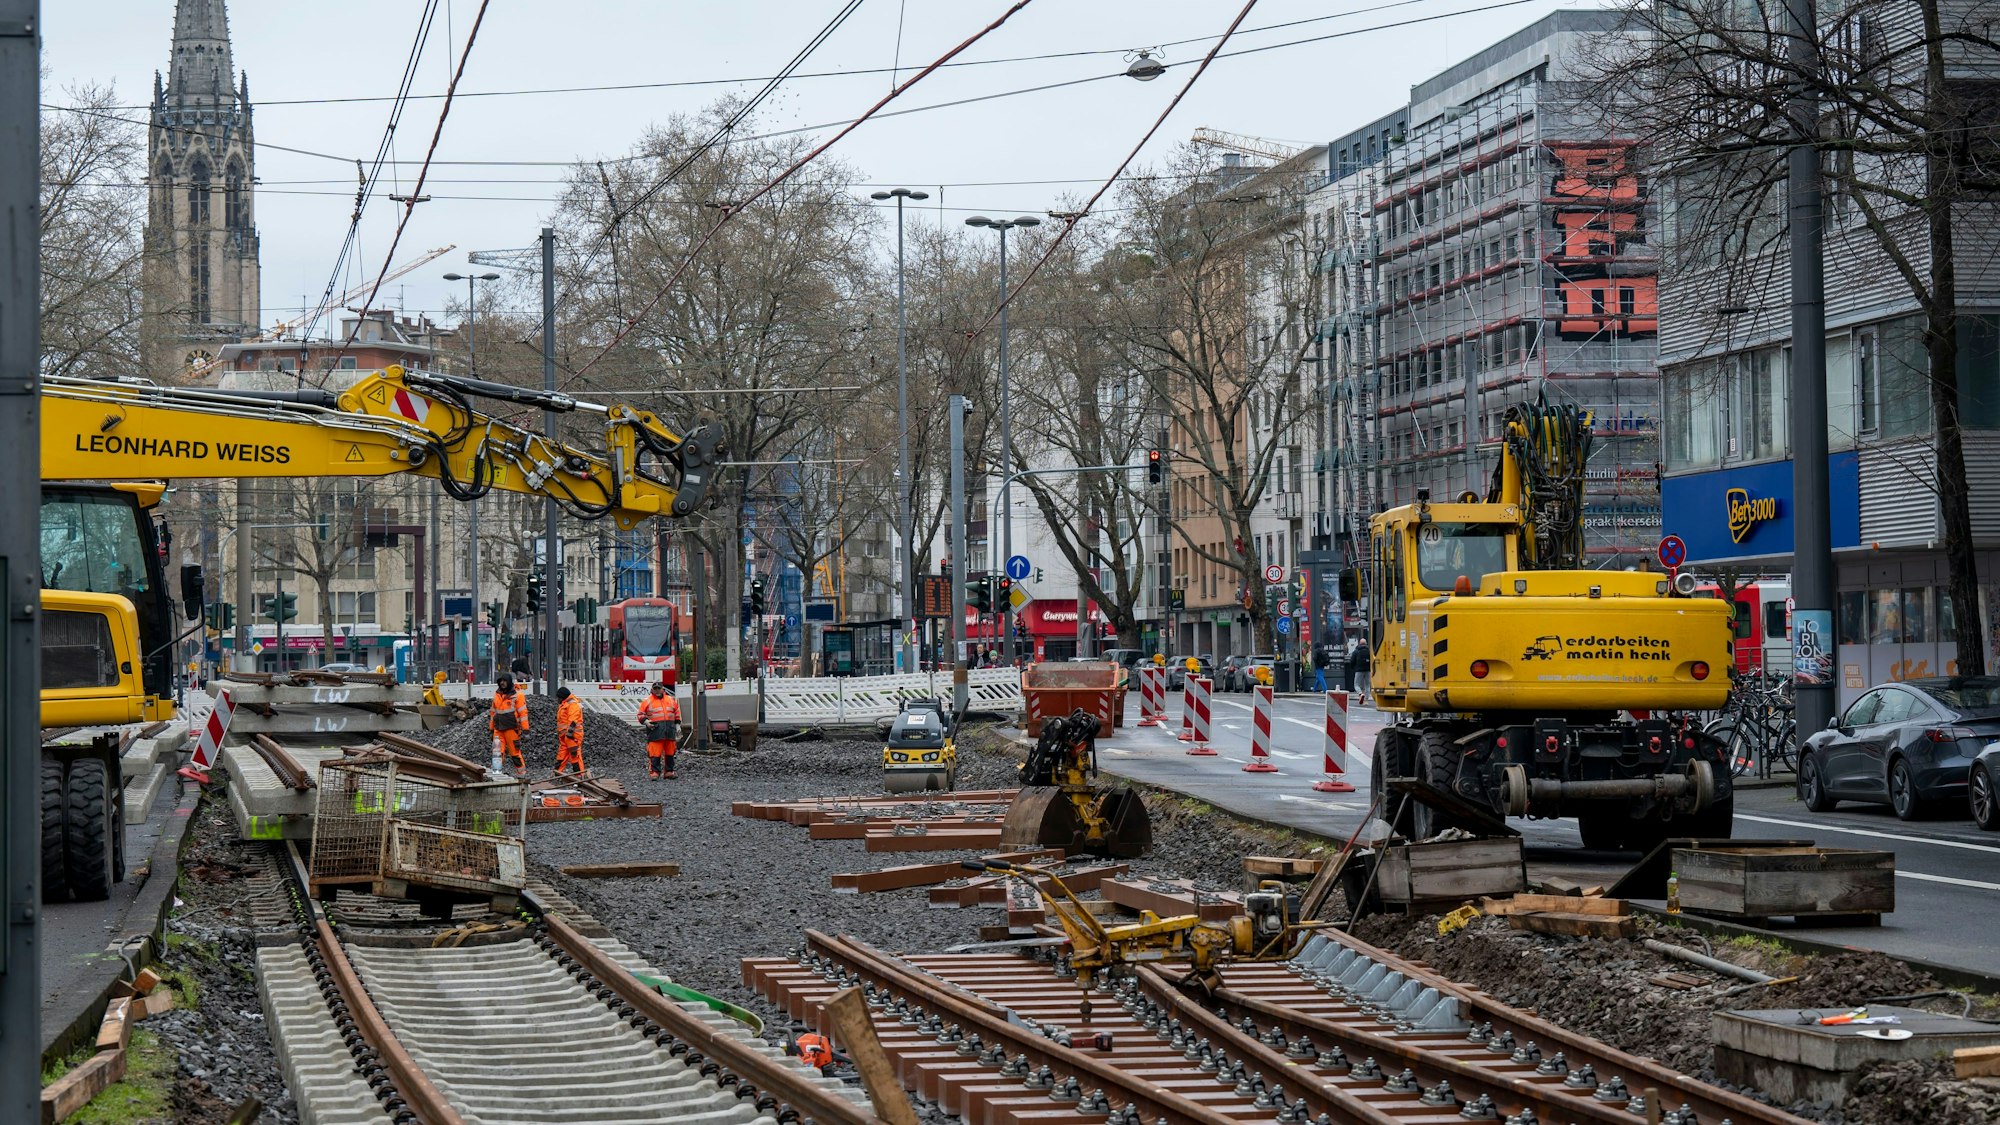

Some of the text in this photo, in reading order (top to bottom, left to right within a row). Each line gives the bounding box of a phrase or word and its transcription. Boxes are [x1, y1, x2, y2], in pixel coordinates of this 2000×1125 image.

[75, 434, 291, 464] LEONHARD WEISS
[1424, 527, 1439, 542] 20
[1269, 569, 1280, 578] 30
[1797, 620, 1819, 633] HO
[1565, 635, 1670, 648] erdarbeiten
[1801, 633, 1815, 645] RI
[1566, 648, 1671, 661] martin henk
[1796, 645, 1824, 657] ZON
[1800, 657, 1817, 670] TE
